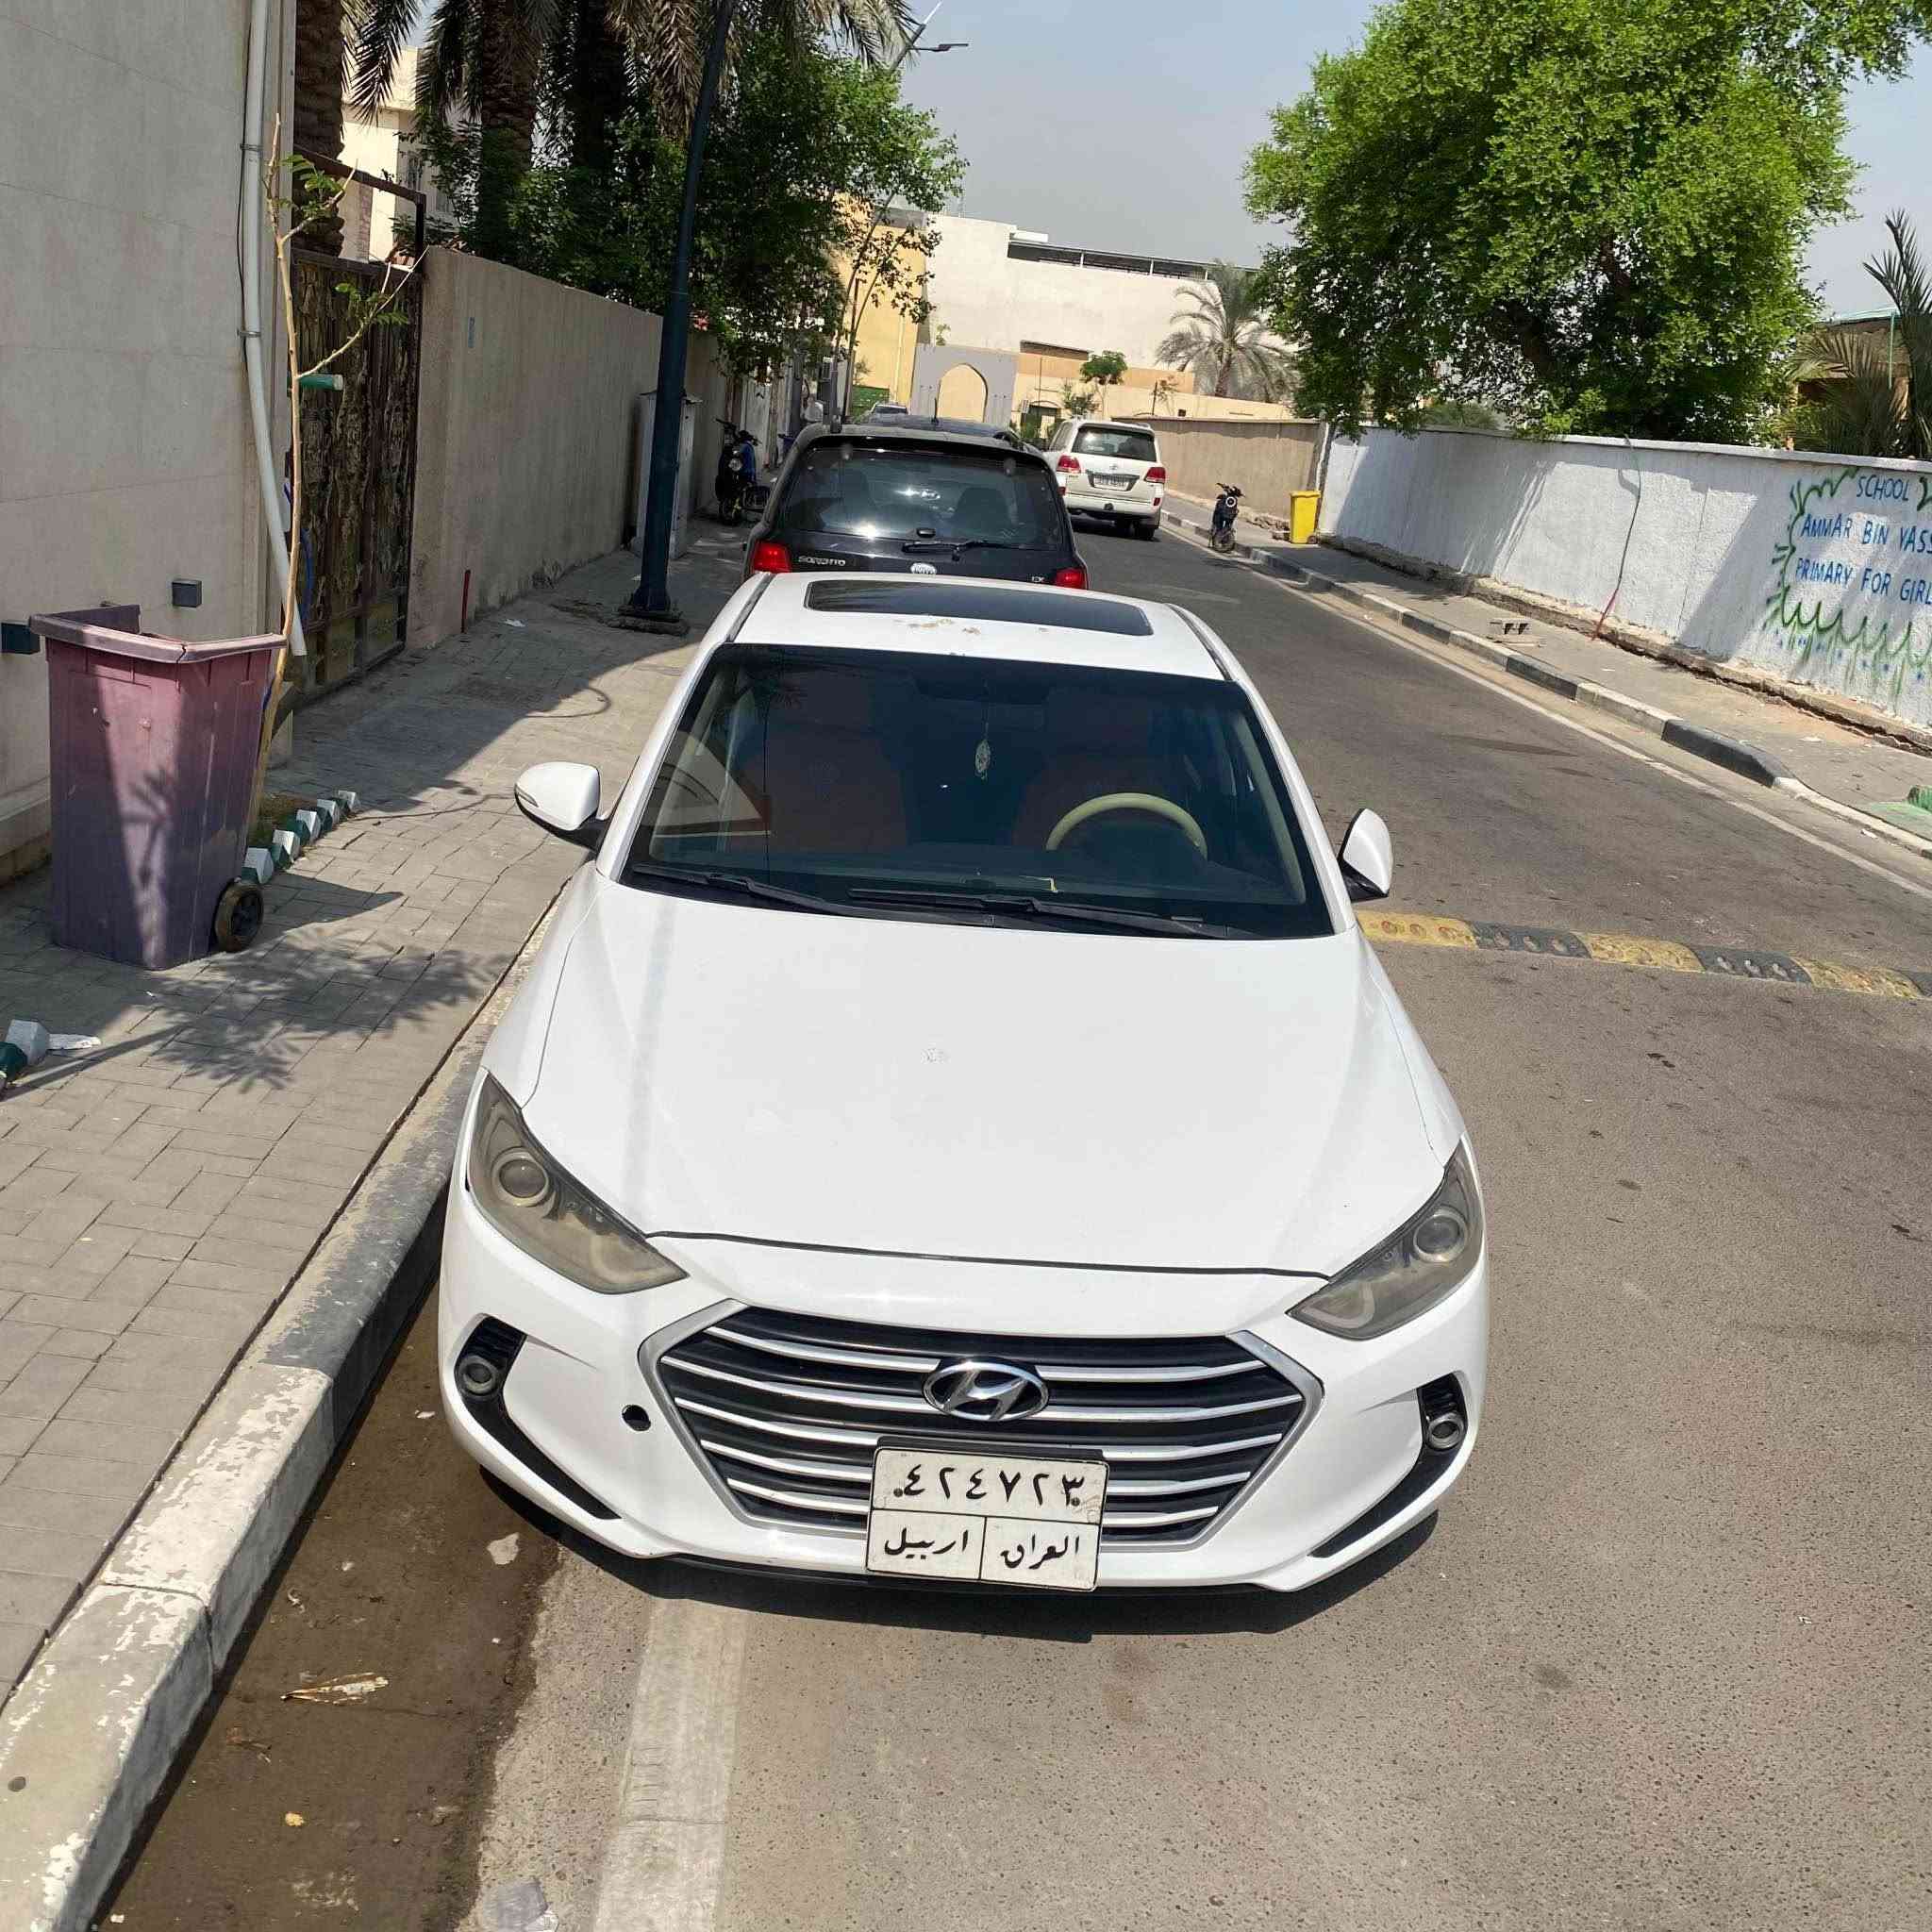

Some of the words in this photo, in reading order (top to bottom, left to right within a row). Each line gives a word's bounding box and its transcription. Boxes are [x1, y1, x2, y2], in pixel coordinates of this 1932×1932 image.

[1856, 475, 1909, 501] SCHOOL
[1800, 513, 1853, 538] AMMAR
[1861, 520, 1889, 545] BIN
[1795, 558, 1853, 585] PRIMARY
[1860, 568, 1891, 596] FOR
[904, 1464, 1084, 1507] ٤٢٤٧٢٣
[884, 1527, 969, 1559] اربيل
[1000, 1534, 1079, 1570] العراق
